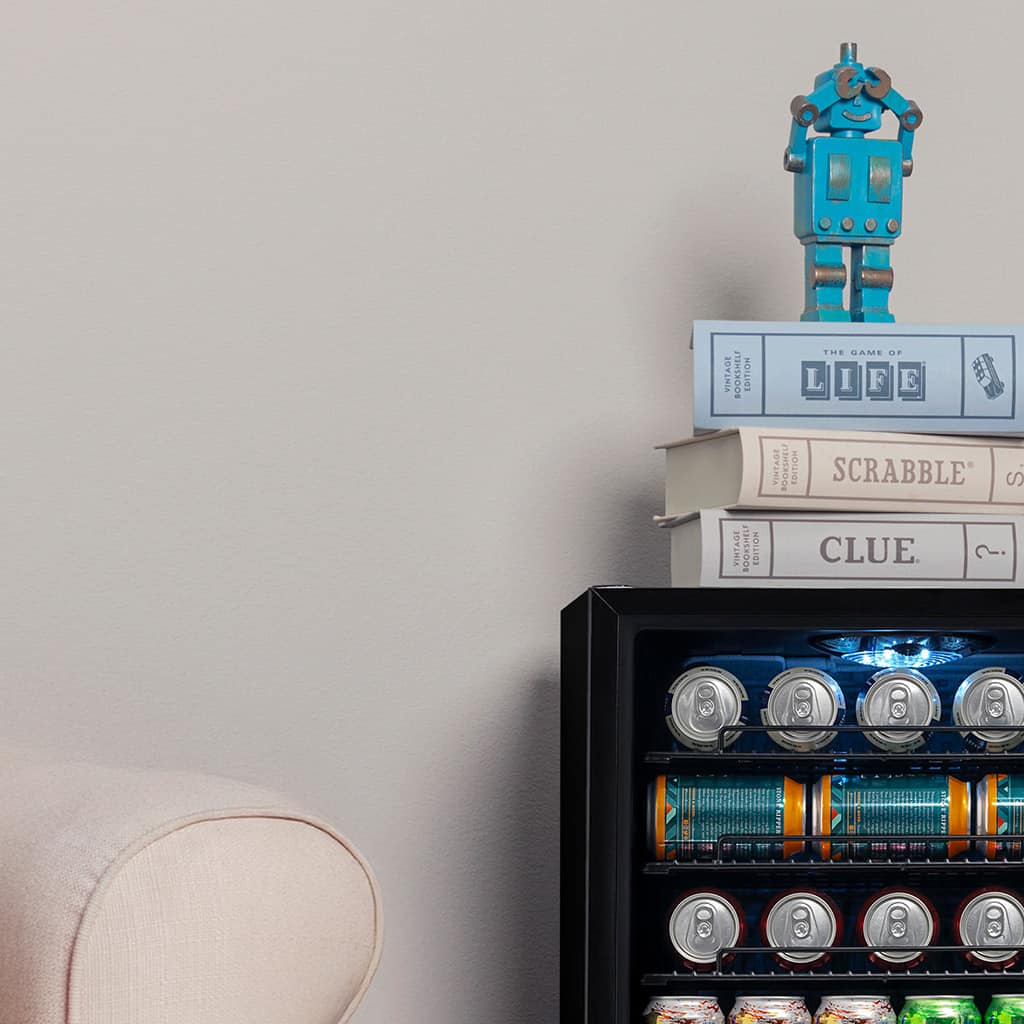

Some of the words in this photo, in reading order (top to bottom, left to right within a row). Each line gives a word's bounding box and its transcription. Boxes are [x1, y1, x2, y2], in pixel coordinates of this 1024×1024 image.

[804, 365, 921, 394] LIFE
[772, 448, 780, 485] VINTAGE
[833, 456, 966, 485] SCRABBLE
[742, 524, 750, 572] BOOKSHELF
[819, 536, 915, 564] CLUE
